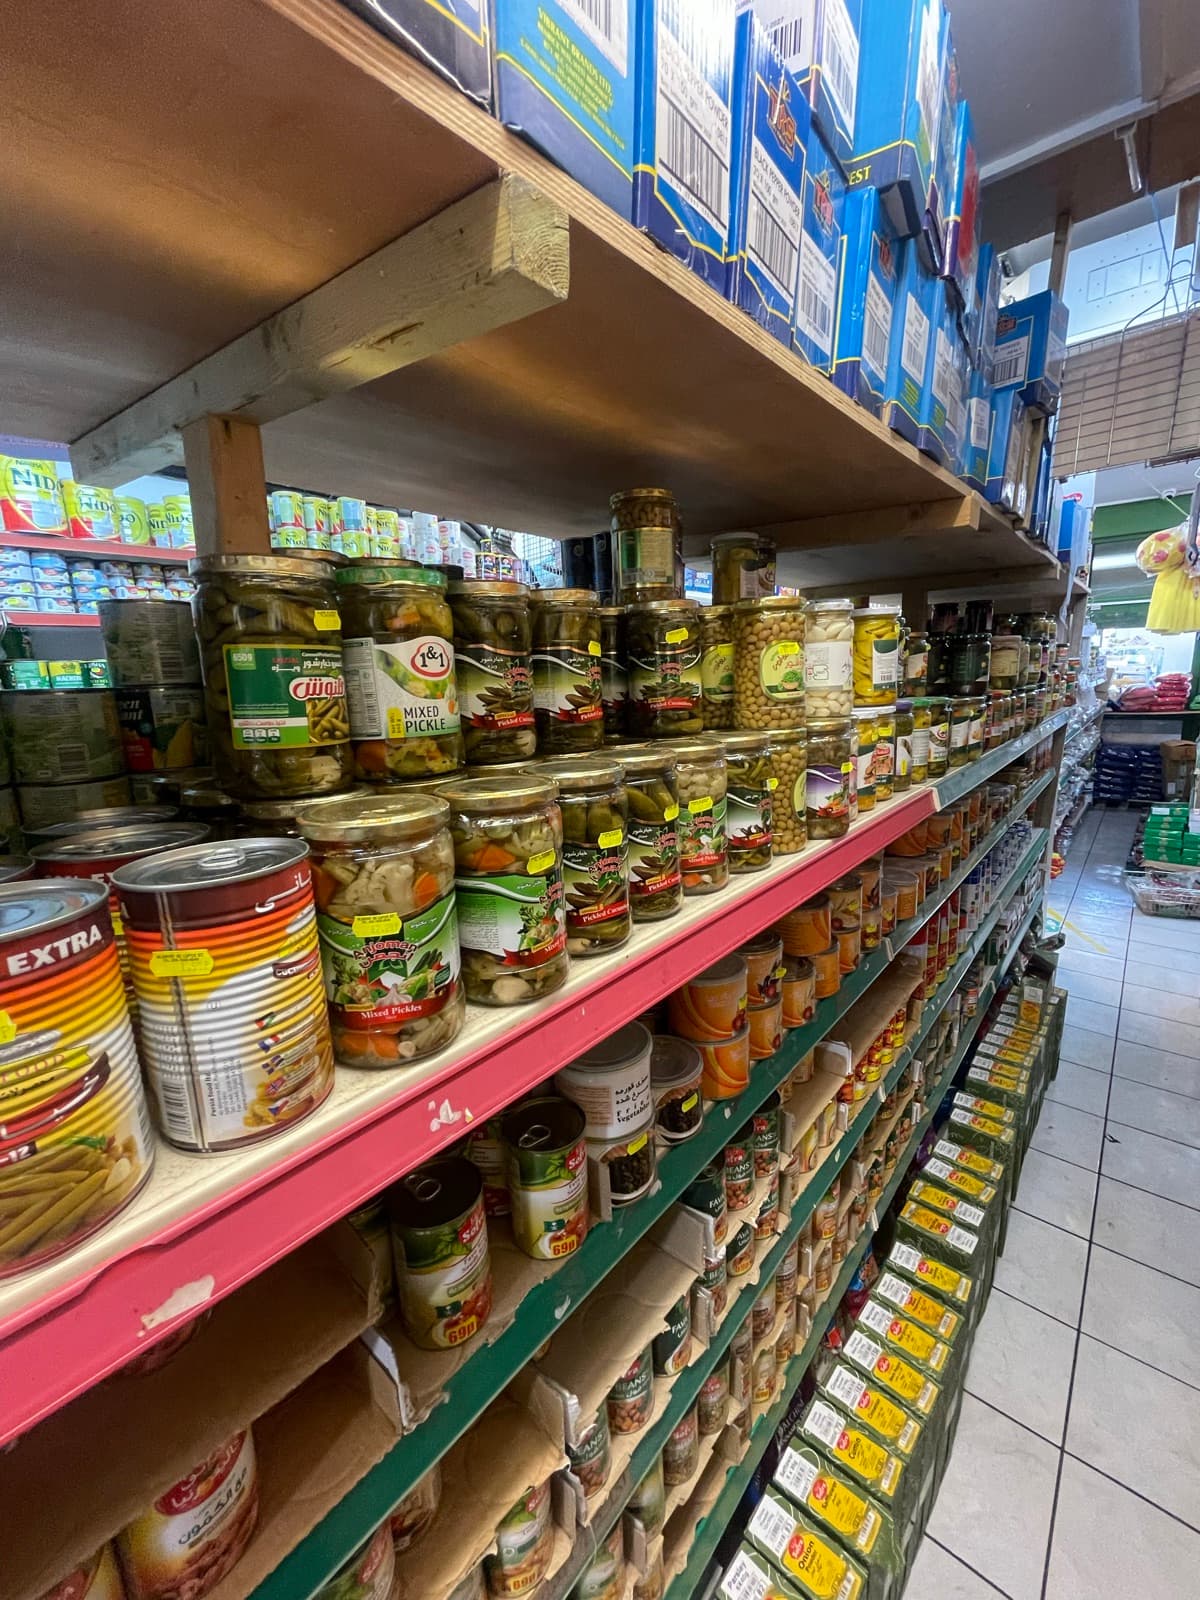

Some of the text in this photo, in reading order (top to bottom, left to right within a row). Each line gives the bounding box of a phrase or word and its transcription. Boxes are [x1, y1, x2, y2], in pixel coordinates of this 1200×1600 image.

[849, 165, 872, 186] EST
[419, 645, 446, 668] 1&1
[403, 705, 439, 719] MIXED
[405, 718, 447, 733] PICKLE
[6, 924, 102, 977] EXTRA
[361, 1003, 423, 1020] Mixed Pickles
[447, 1318, 477, 1344] 69p
[797, 1539, 814, 1569] Onion
[726, 1559, 746, 1590] Parsley
